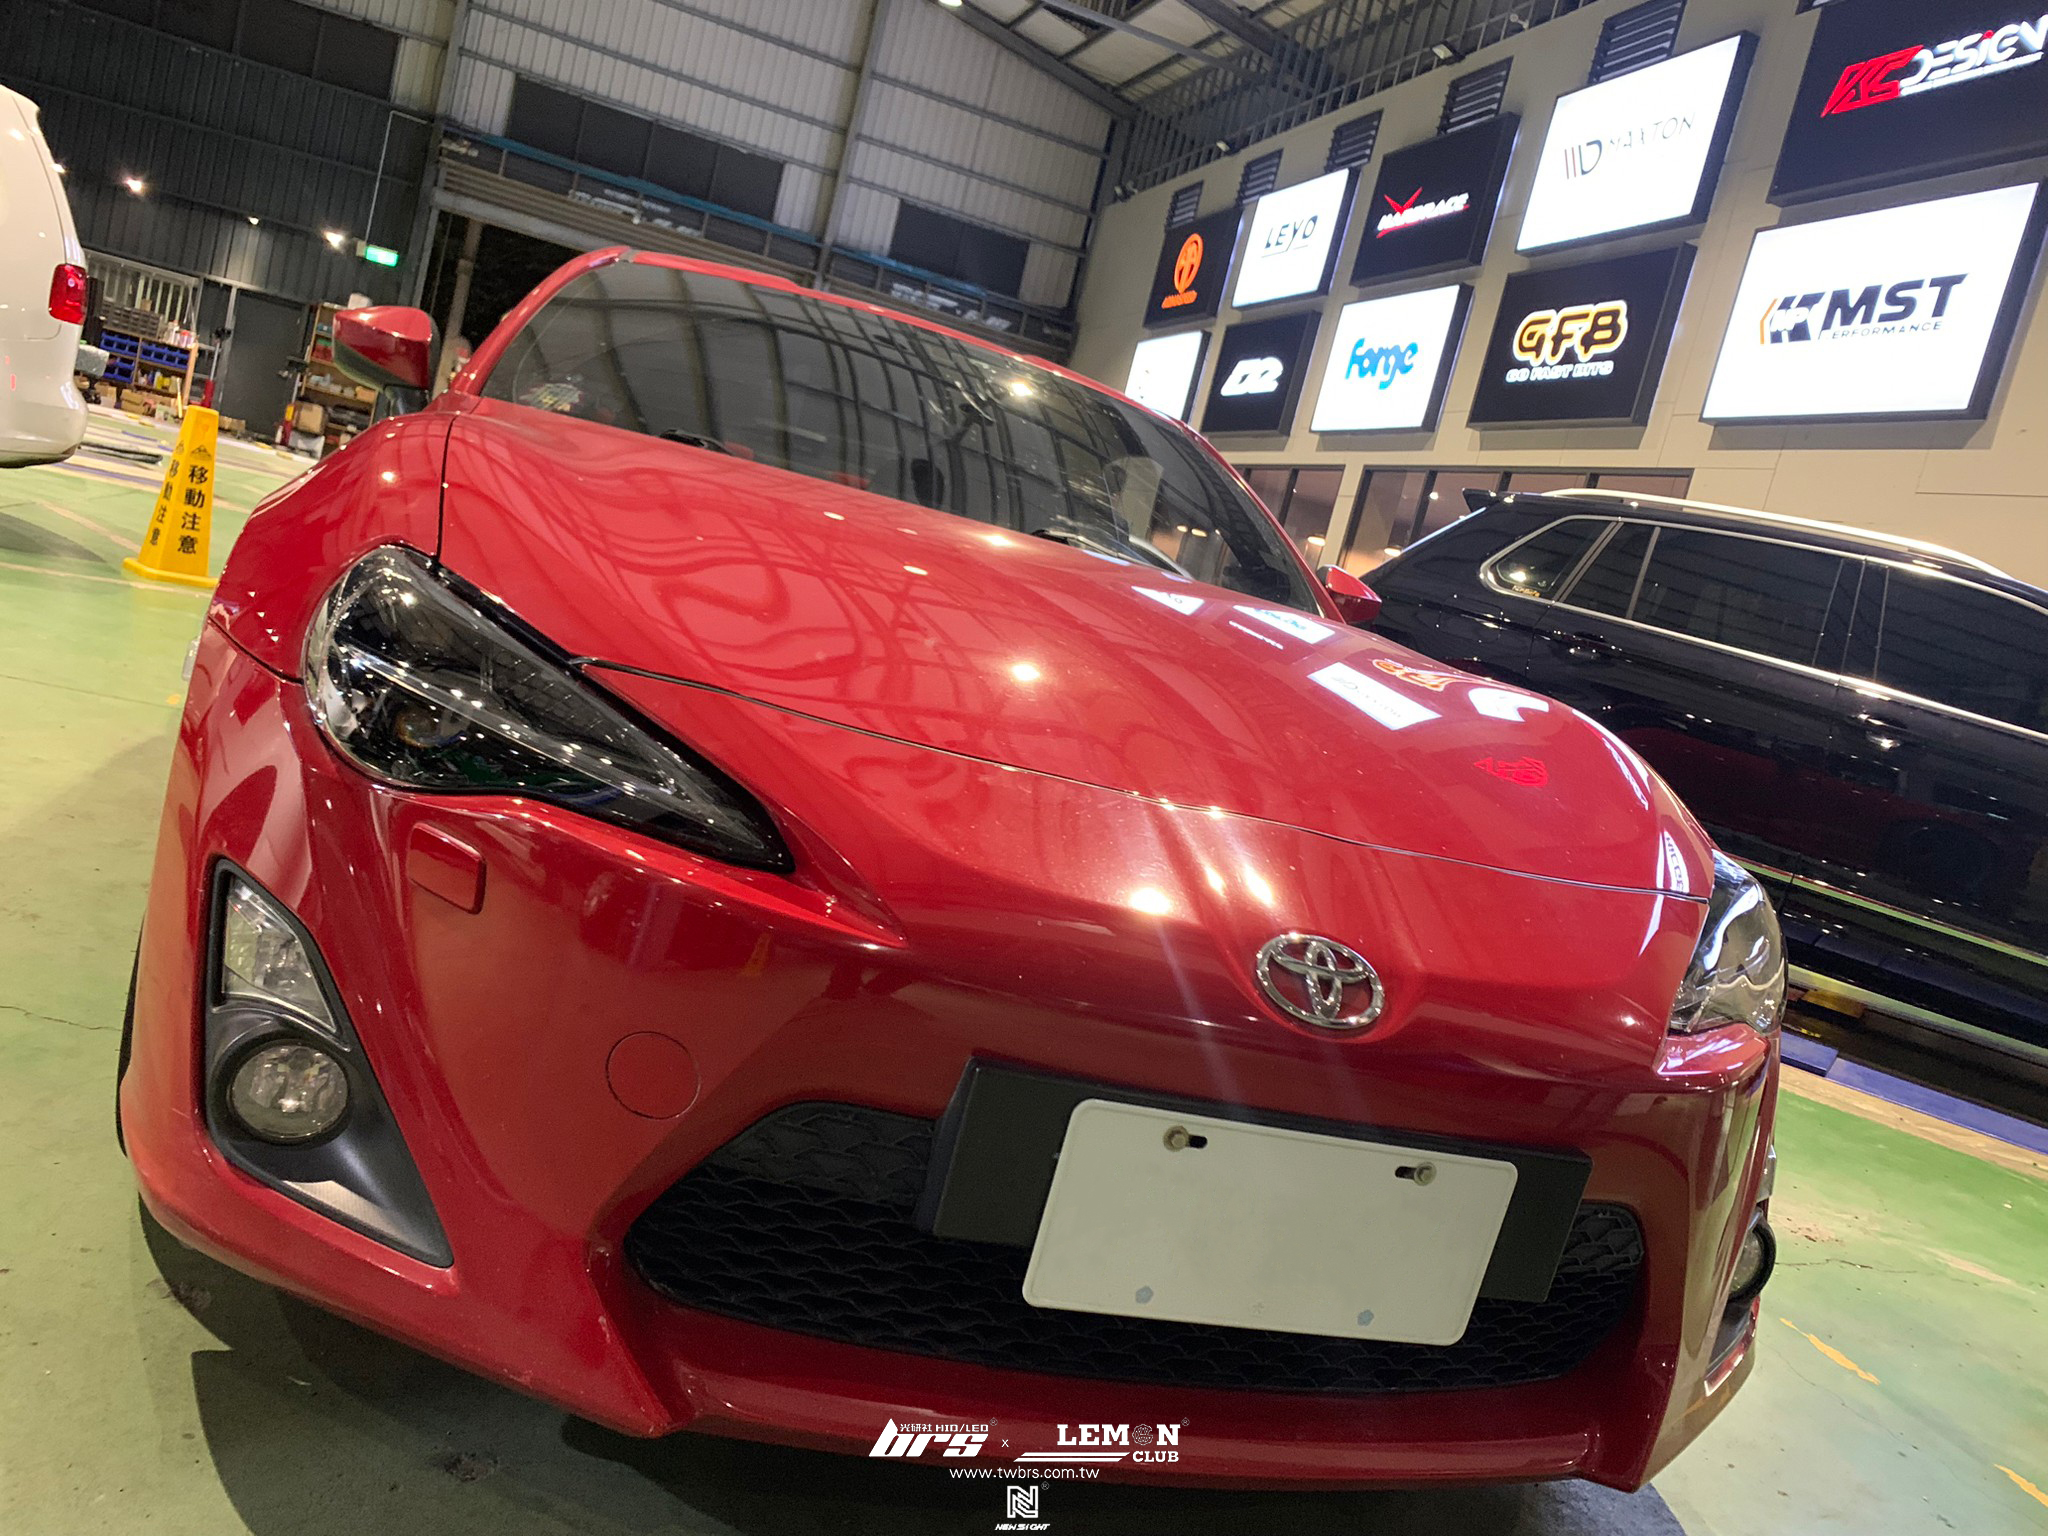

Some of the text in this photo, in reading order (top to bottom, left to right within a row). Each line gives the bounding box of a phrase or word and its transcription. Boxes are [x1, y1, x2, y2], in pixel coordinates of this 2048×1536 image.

[1264, 215, 1318, 252] LEYO
[1818, 321, 1943, 340] ERFORMANCE
[1821, 273, 1968, 331] MST
[1513, 300, 1628, 366] GFB
[177, 464, 209, 554] 移動注意
